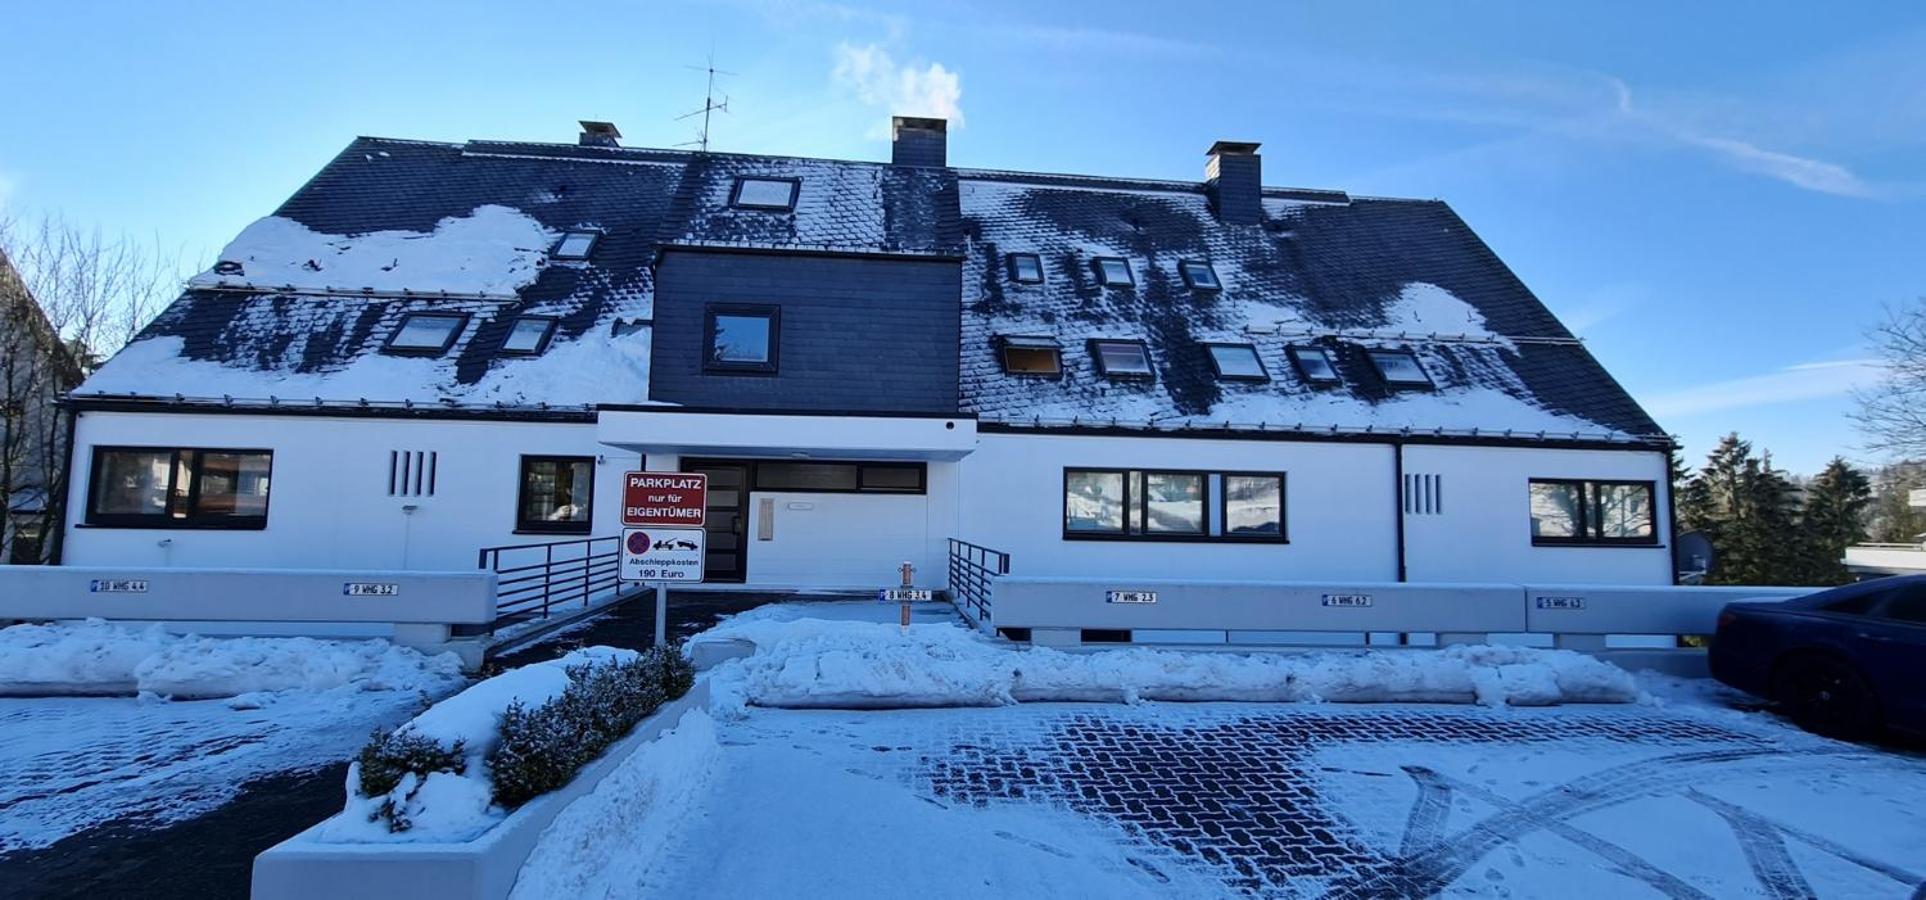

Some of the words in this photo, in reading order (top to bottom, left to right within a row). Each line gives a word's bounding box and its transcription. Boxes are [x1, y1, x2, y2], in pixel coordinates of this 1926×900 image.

[630, 478, 702, 489] PARKPLATZ
[667, 494, 682, 503] für
[627, 506, 701, 518] EIGENTÜMER
[629, 558, 699, 567] Abschleppkosten
[661, 570, 685, 578] Euro
[112, 581, 129, 590] WHG
[354, 584, 360, 594] 9
[362, 584, 378, 594] WHG
[890, 591, 895, 600] 8
[897, 591, 912, 600] WHG
[1115, 592, 1120, 601] 7
[1123, 593, 1138, 601] WHG
[1339, 597, 1353, 605] WHG
[1553, 599, 1567, 607] WHG
